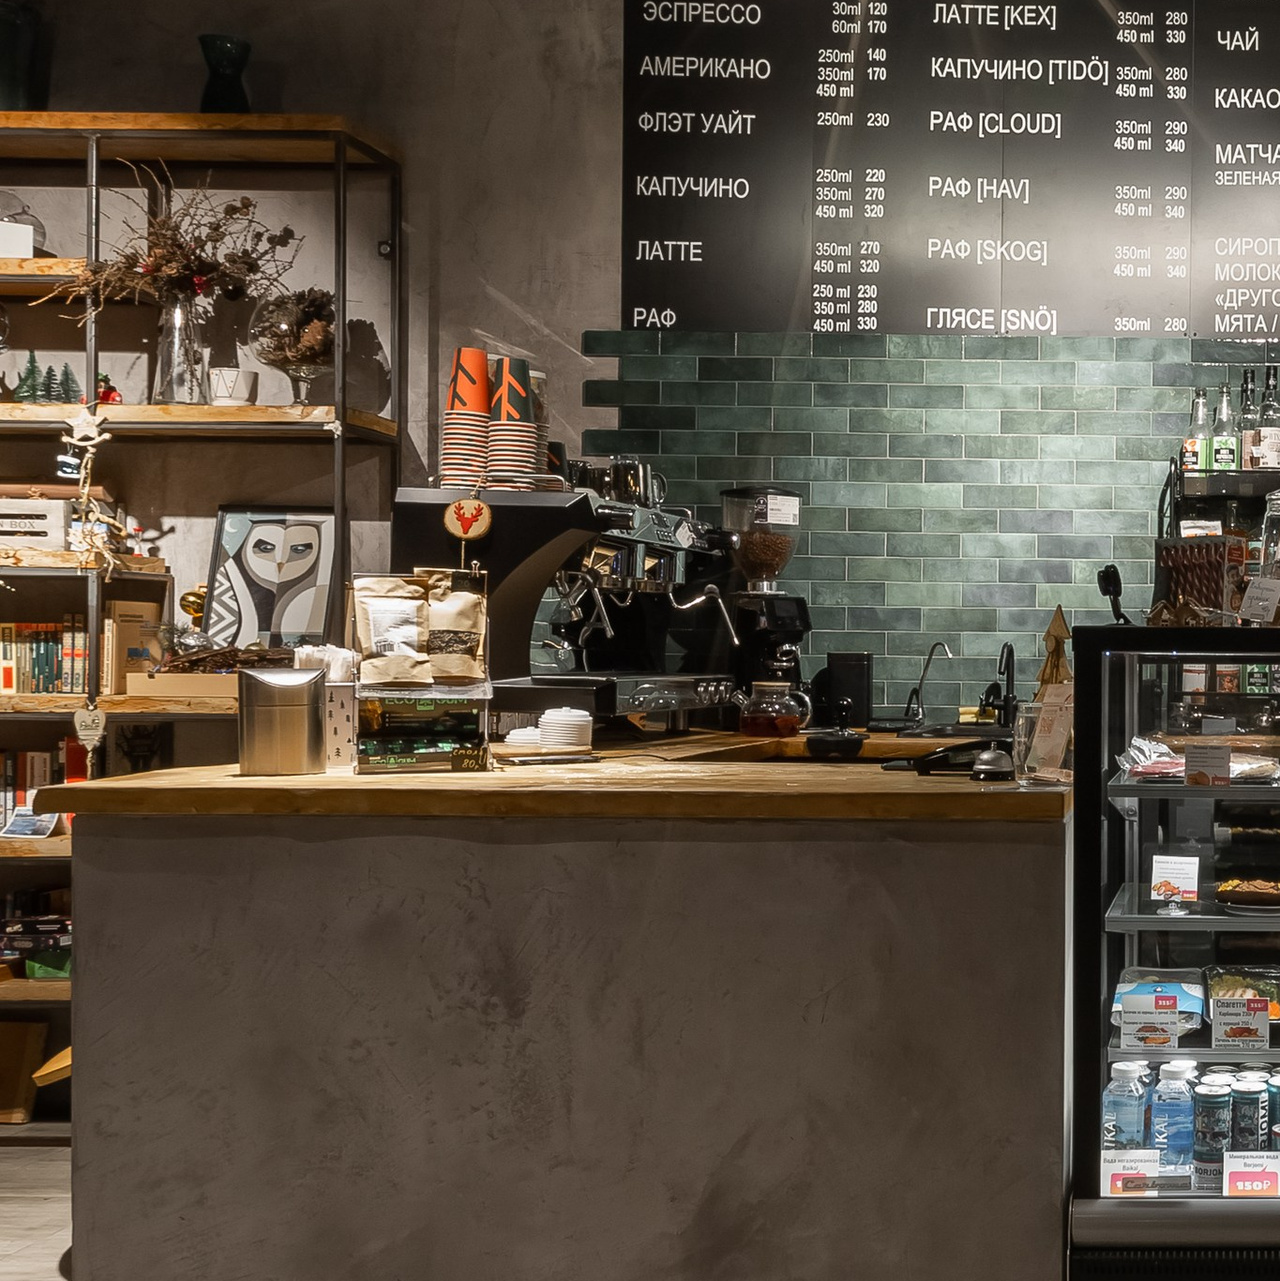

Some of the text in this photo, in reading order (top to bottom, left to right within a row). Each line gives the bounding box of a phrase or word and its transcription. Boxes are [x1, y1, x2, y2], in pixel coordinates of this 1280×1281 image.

[643, 1, 887, 24] ЭСПРЕССО 30ml 120
[933, 4, 999, 24] ЛАТТЕ
[1118, 12, 1153, 25] 350ml
[1166, 12, 1187, 25] 280
[832, 21, 886, 34] 60ml 170
[1117, 30, 1185, 43] 450 ml 330
[1218, 27, 1259, 51] ЧАЙ
[640, 49, 886, 79] АМЕРИКАНО 250ml 140
[932, 58, 1042, 80] КАПУЧИНО
[1117, 67, 1152, 80] 350ml
[1166, 68, 1187, 81] 280
[818, 68, 886, 81] 350ml 170
[816, 84, 853, 97] 450 ml
[1116, 84, 1186, 99] 450 ml 330
[1215, 88, 1280, 109] КАКАО
[638, 110, 889, 134] ФЛЭТ УАЙТ 250ml 230
[930, 111, 972, 132] РАФ
[1116, 121, 1151, 134] 350ml
[1165, 122, 1187, 135] 290
[1114, 137, 1185, 152] 450 ml 340
[636, 169, 885, 199] КАПУЧИНО 250ml 220
[1215, 171, 1280, 186] ЗЕЛЕНАЯ
[816, 187, 885, 201] 350ml 270
[929, 177, 971, 197] РАФ
[1115, 186, 1150, 199] 350ml
[1165, 187, 1187, 200] 290
[816, 205, 883, 218] 450 ml 320
[1115, 203, 1184, 218] 450 ml 340
[636, 241, 880, 261] ЛАТТЕ 350ml 270
[928, 239, 970, 259] РАФ
[1115, 246, 1150, 259] 350ml
[1165, 247, 1186, 259] 290
[1215, 238, 1280, 256] СИРОП
[814, 260, 879, 273] 450 ml 320
[1114, 264, 1186, 278] 450 ml 340
[813, 285, 877, 298] 250 ml 230
[814, 300, 877, 315] 350 ml 280
[633, 308, 877, 332] РАФ 450 ml 330
[927, 308, 994, 329] ГЛЯСЕ
[1115, 318, 1150, 331] 350ml
[1164, 318, 1186, 332] 280
[1215, 315, 1267, 332] МЯТА
[10, 521, 36, 529] BOX
[1216, 999, 1247, 1009] Спагетти
